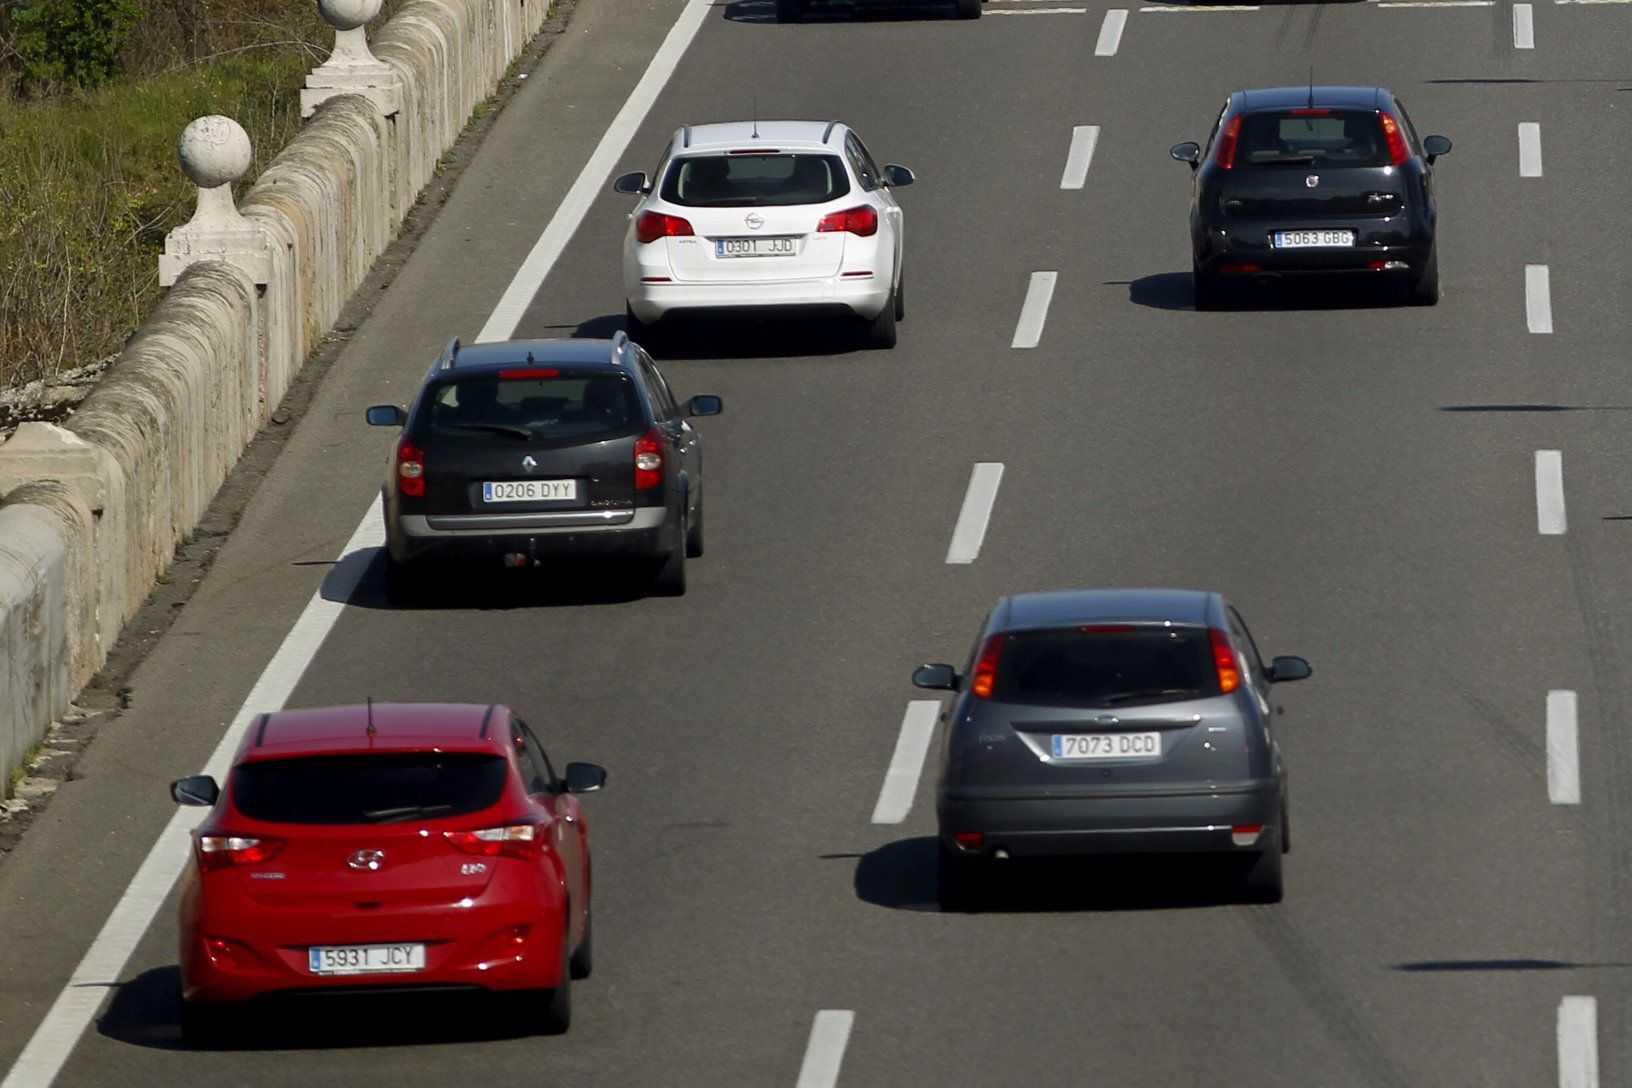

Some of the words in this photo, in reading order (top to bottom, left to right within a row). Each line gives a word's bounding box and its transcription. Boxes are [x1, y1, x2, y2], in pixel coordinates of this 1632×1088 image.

[726, 239, 757, 253] 0301
[768, 238, 793, 252] JJD
[1285, 233, 1319, 245] 5063
[1323, 231, 1349, 243] GBG
[496, 484, 536, 498] 0206
[541, 483, 571, 496] DYY
[1066, 736, 1112, 754] 7073
[1119, 735, 1154, 752] DCD
[326, 949, 369, 967] 5931
[382, 947, 414, 965] JCY
